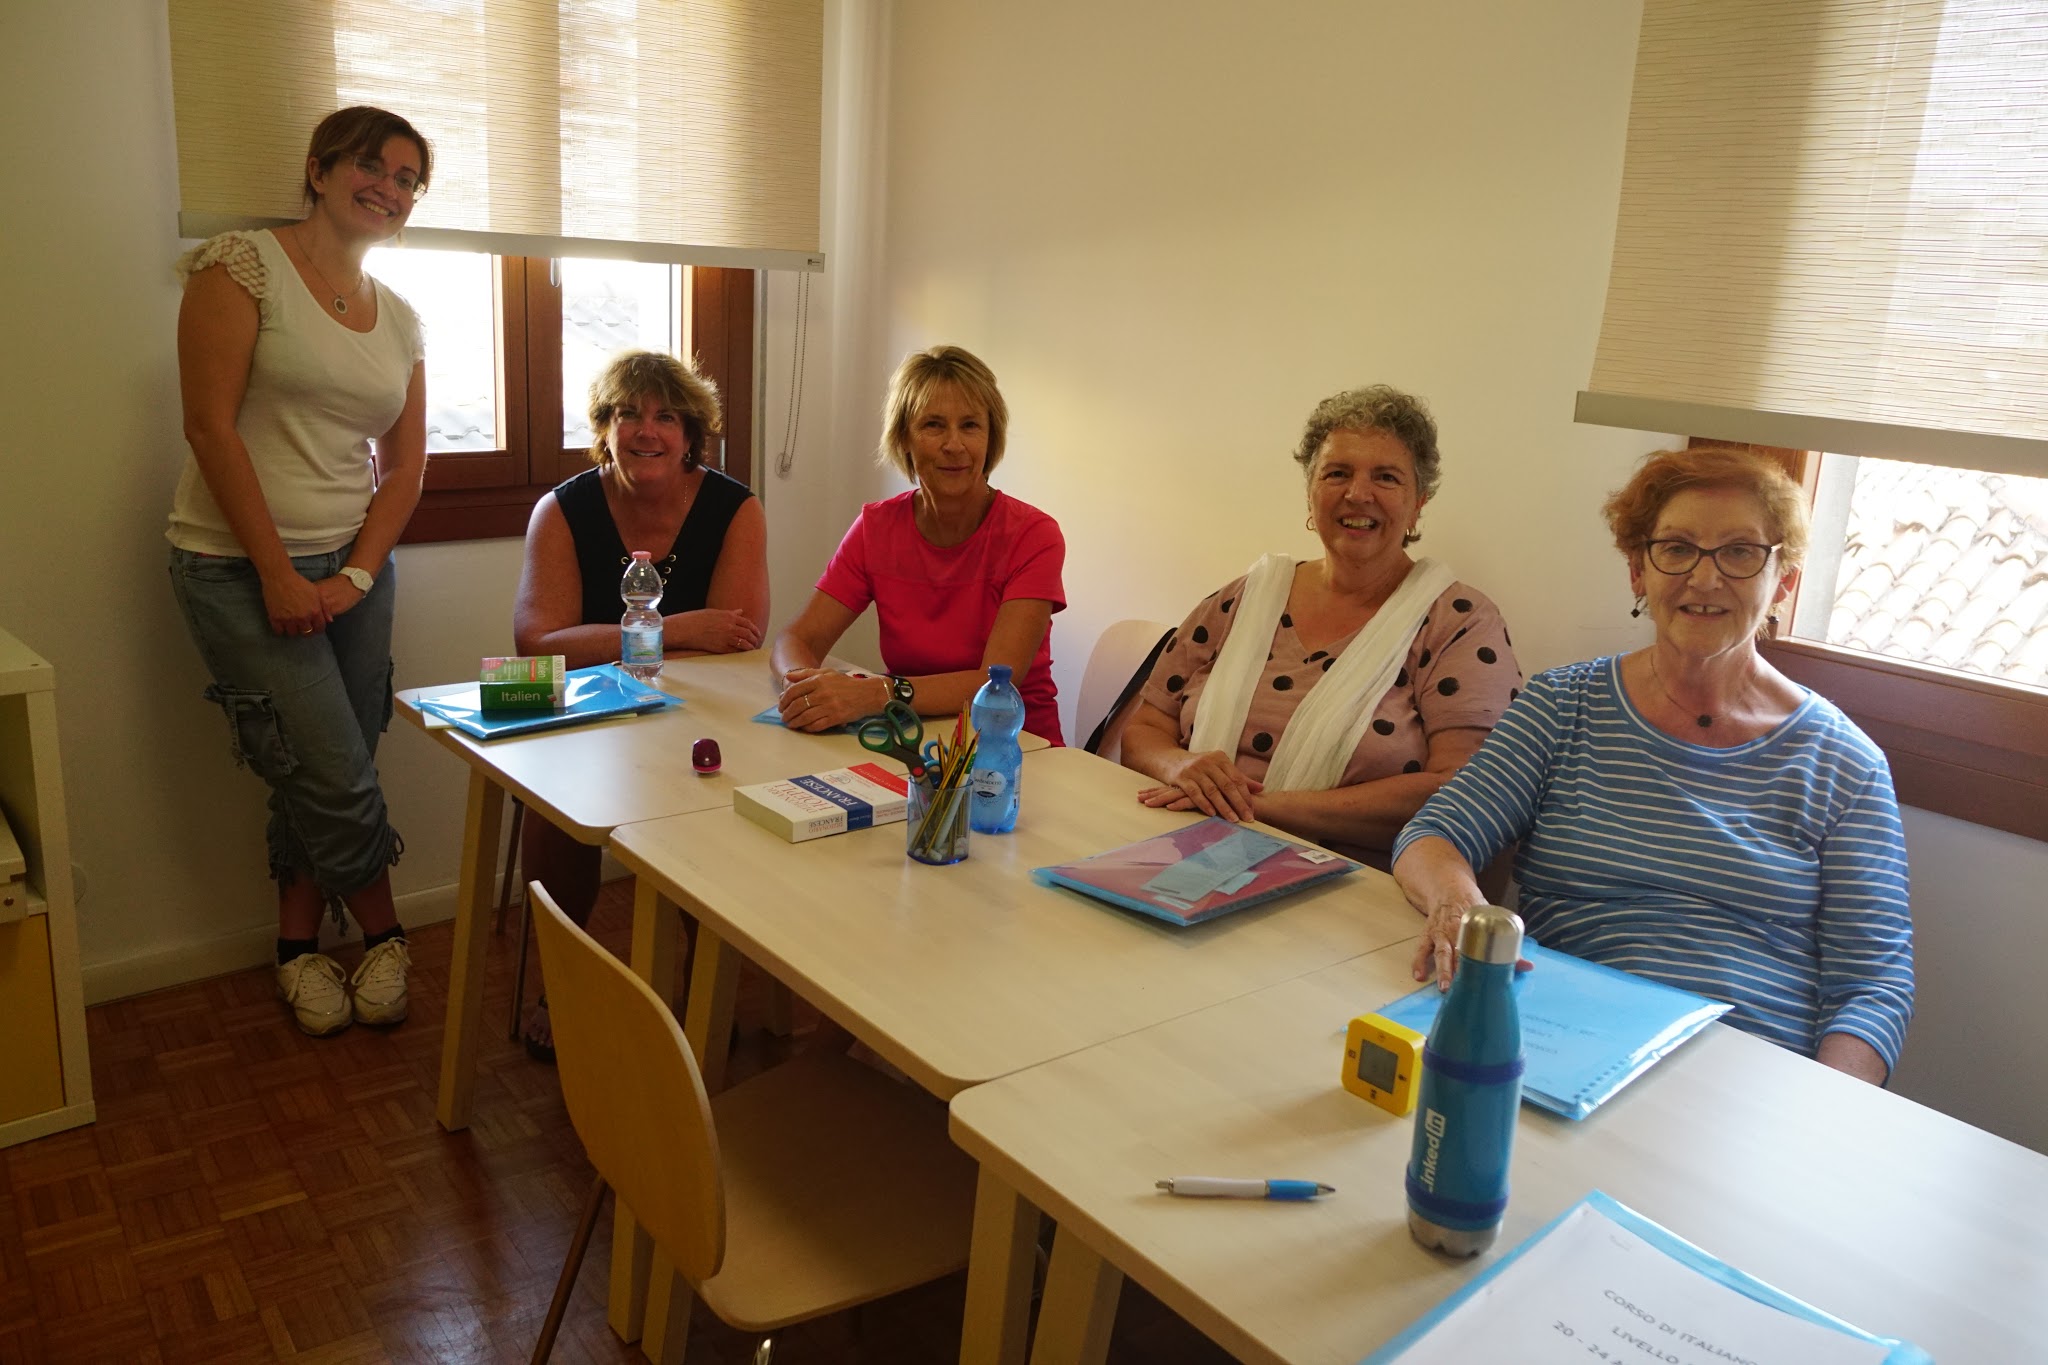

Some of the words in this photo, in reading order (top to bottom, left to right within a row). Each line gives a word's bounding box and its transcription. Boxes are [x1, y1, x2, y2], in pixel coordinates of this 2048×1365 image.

[538, 661, 548, 678] Italien
[501, 691, 541, 702] Italien
[774, 783, 834, 811] HOEPLI
[800, 778, 858, 806] FRANCESE
[808, 815, 843, 828] FRANCESE
[1603, 1289, 1656, 1325] CORSO
[1658, 1322, 1677, 1336] DI
[1552, 1319, 1575, 1337] 20
[1587, 1343, 1609, 1360] 24
[1612, 1326, 1679, 1364] LIVELLO
